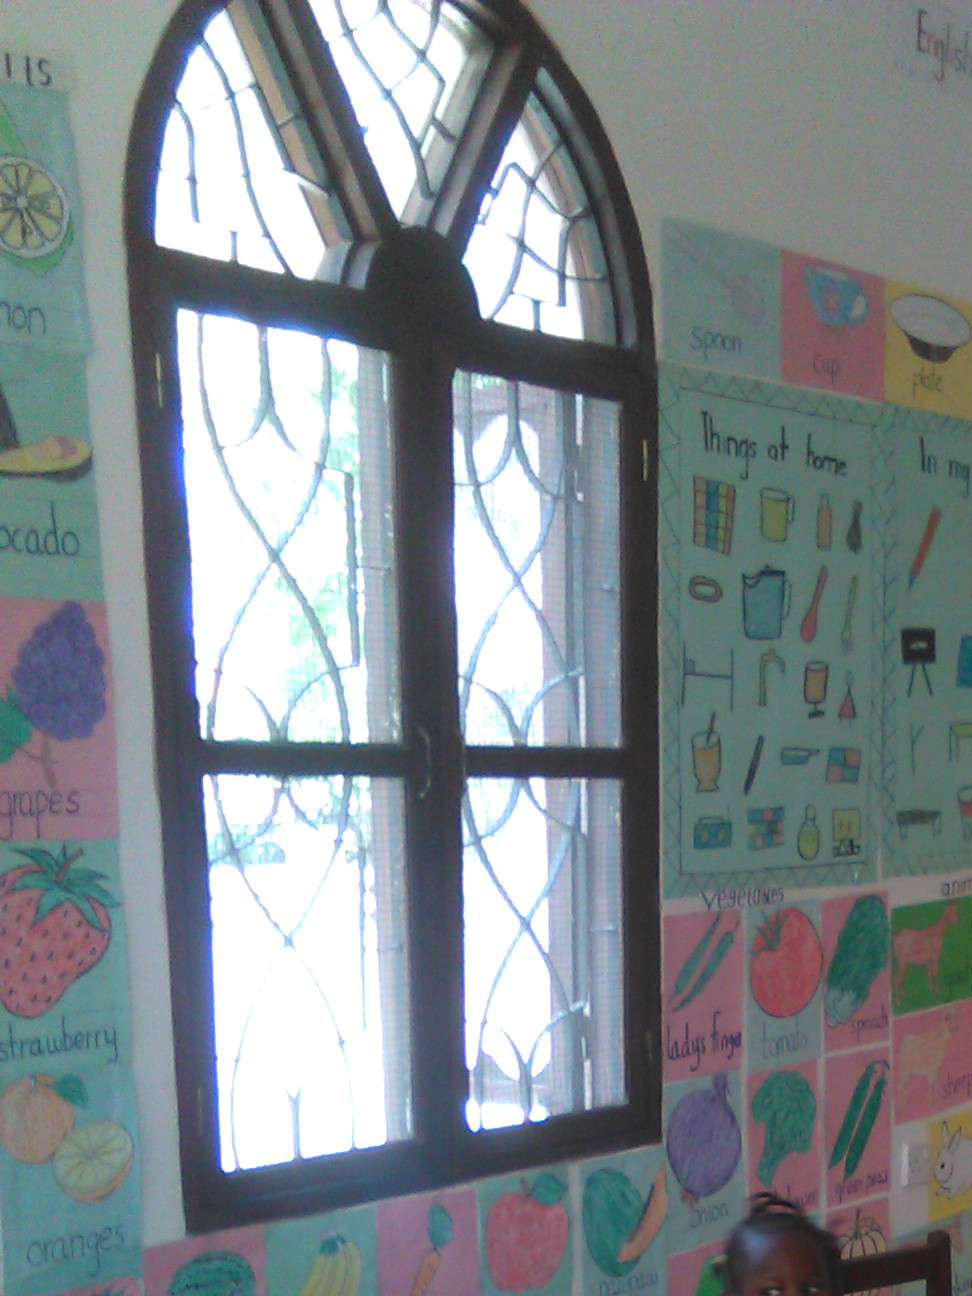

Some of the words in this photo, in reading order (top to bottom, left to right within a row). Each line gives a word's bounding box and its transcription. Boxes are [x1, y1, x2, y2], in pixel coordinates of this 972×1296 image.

[812, 354, 841, 385] cup
[702, 410, 756, 480] Things
[767, 426, 789, 462] at
[805, 433, 848, 477] home
[920, 437, 937, 473] In
[949, 460, 970, 499] my
[26, 1222, 125, 1279] oranges
